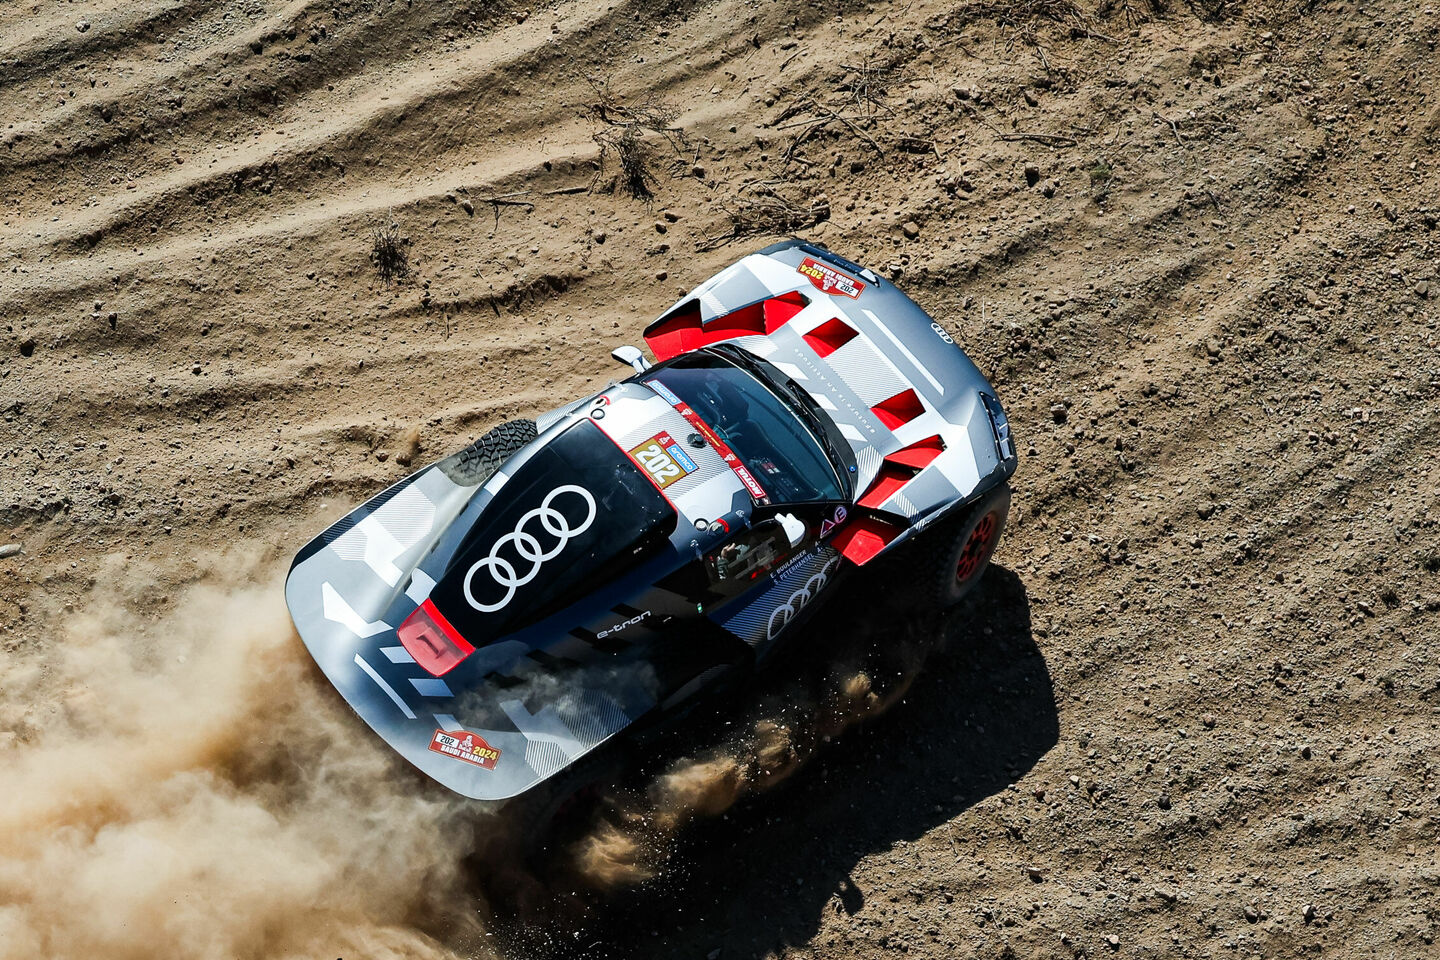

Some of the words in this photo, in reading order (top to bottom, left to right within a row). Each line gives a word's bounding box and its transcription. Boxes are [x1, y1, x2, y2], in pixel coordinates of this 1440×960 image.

[799, 264, 824, 280] 2024
[840, 283, 854, 294] 202
[635, 444, 680, 484] 202
[671, 447, 694, 470] aramco
[738, 468, 763, 495] MOTUL
[776, 549, 807, 575] BOULANGER
[779, 553, 815, 581] PETERHANSEL
[597, 611, 651, 639] e-tron
[440, 736, 455, 745] 202
[441, 745, 460, 756] SAUDI
[461, 752, 485, 764] ARABIA
[473, 746, 497, 760] 2024
